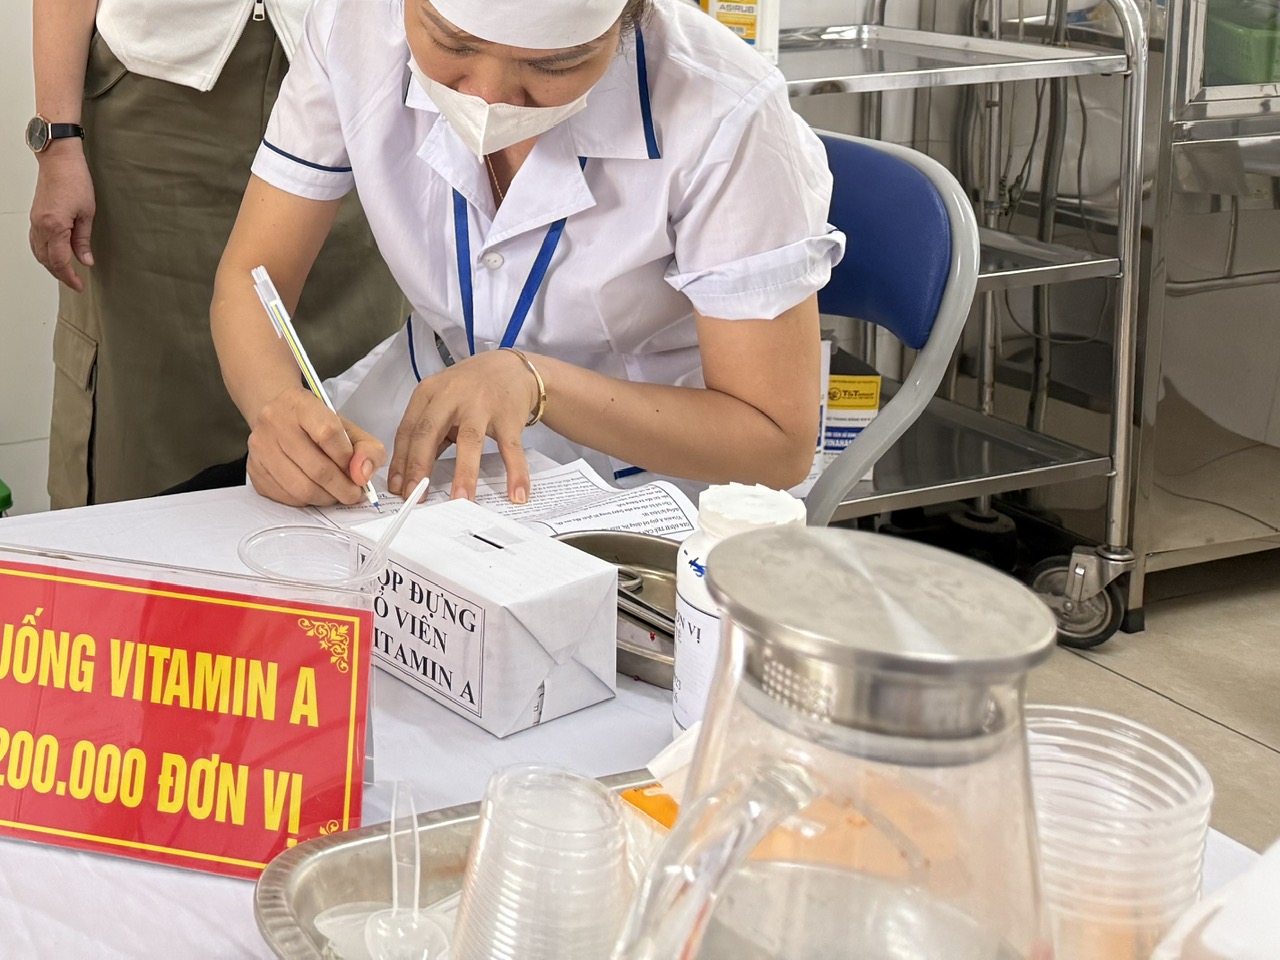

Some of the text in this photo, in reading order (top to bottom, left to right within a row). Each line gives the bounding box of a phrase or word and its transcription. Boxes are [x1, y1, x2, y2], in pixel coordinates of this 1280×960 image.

[719, 3, 754, 13] ASIRUB
[373, 589, 448, 655] Ỏ VIÊN
[409, 579, 477, 633] ĐỰNG
[111, 639, 277, 721] VITAMIN
[290, 666, 319, 727] A
[373, 626, 476, 706] ITAMIN A
[158, 753, 248, 826] ĐƠN
[264, 769, 303, 849] VỊ
